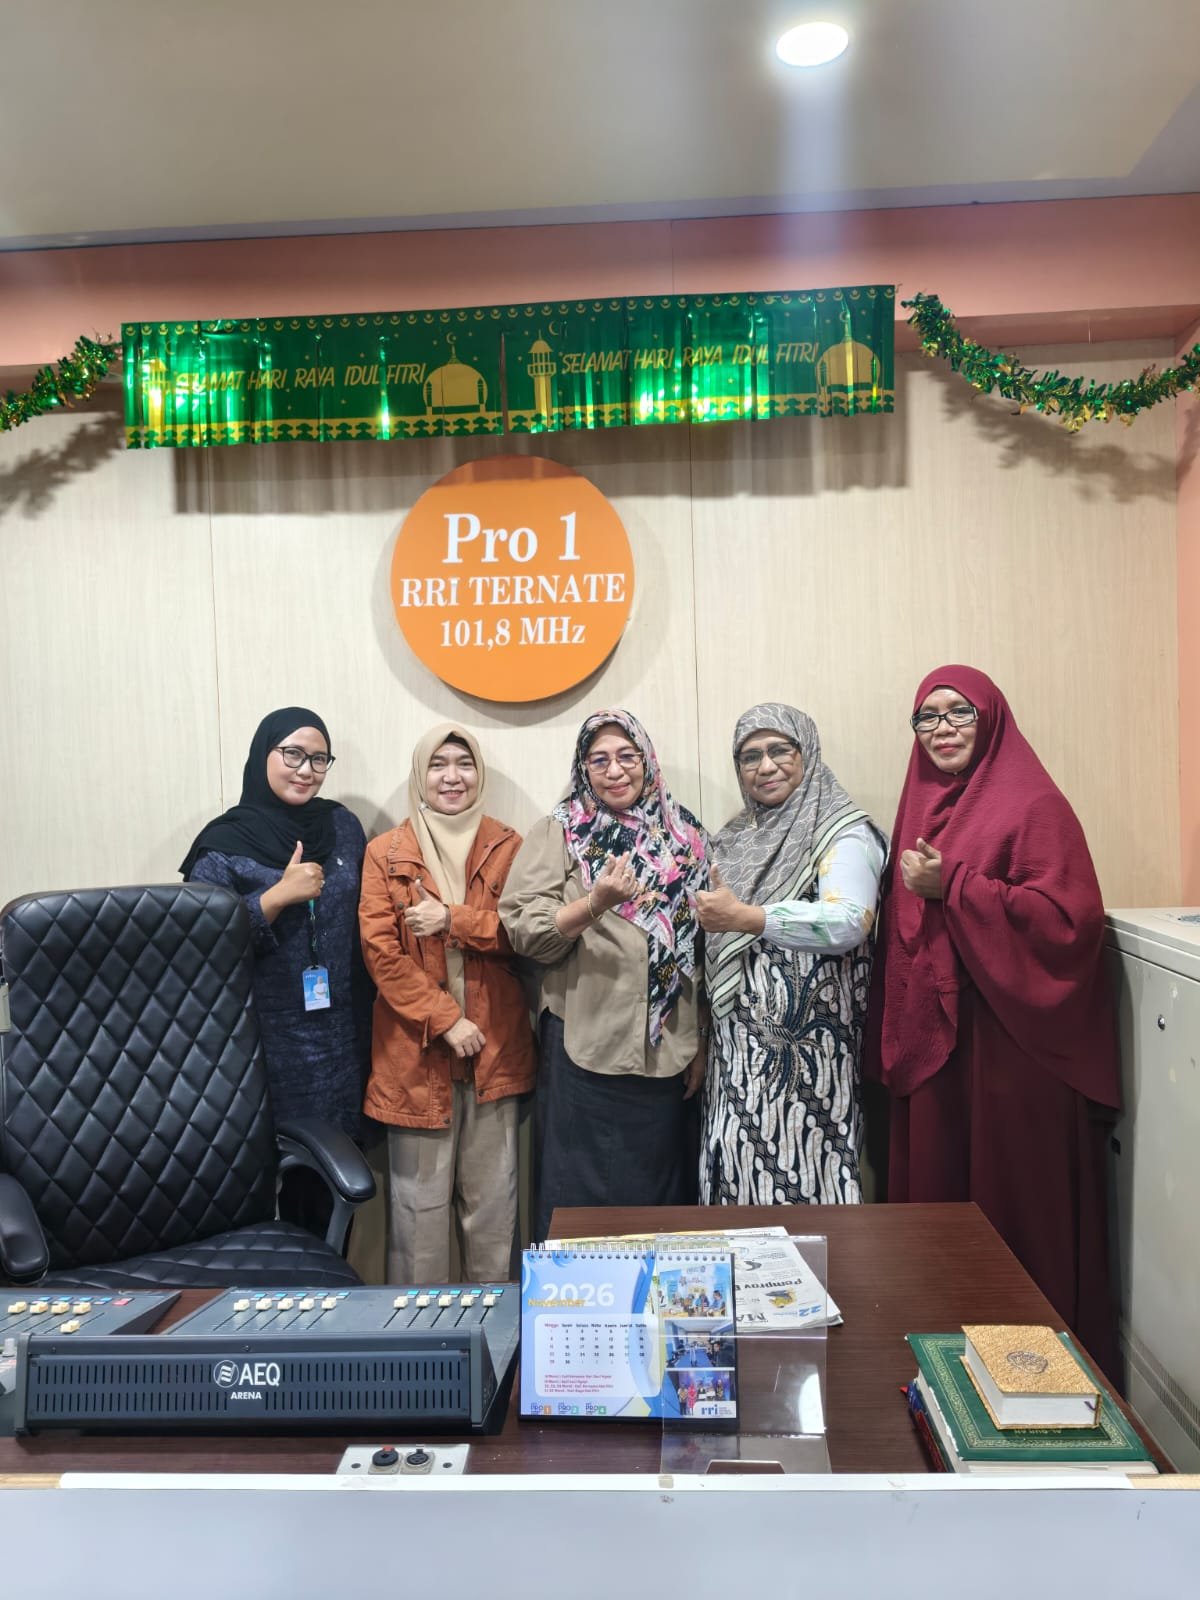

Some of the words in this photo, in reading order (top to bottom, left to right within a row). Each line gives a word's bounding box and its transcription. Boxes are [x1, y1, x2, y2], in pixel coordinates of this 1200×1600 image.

[561, 349, 633, 374] SELAMAT
[634, 347, 674, 369] HARI
[682, 344, 722, 367] RAYA
[732, 343, 769, 366] IDUL
[776, 342, 819, 363] FITRI
[247, 368, 288, 390] HARI
[294, 366, 334, 388] RAYA
[344, 364, 380, 386] IDUL
[386, 363, 426, 385] FITRI
[442, 513, 538, 563] Pro
[559, 512, 581, 560] 1
[400, 577, 461, 607] RRI
[468, 573, 626, 605] TERNATE
[440, 619, 511, 650] 101,8
[519, 617, 586, 645] MHz
[542, 1283, 615, 1308] 2026
[238, 1362, 281, 1387] AEQ
[230, 1391, 263, 1400] ARENA
[701, 1404, 718, 1415] rri
